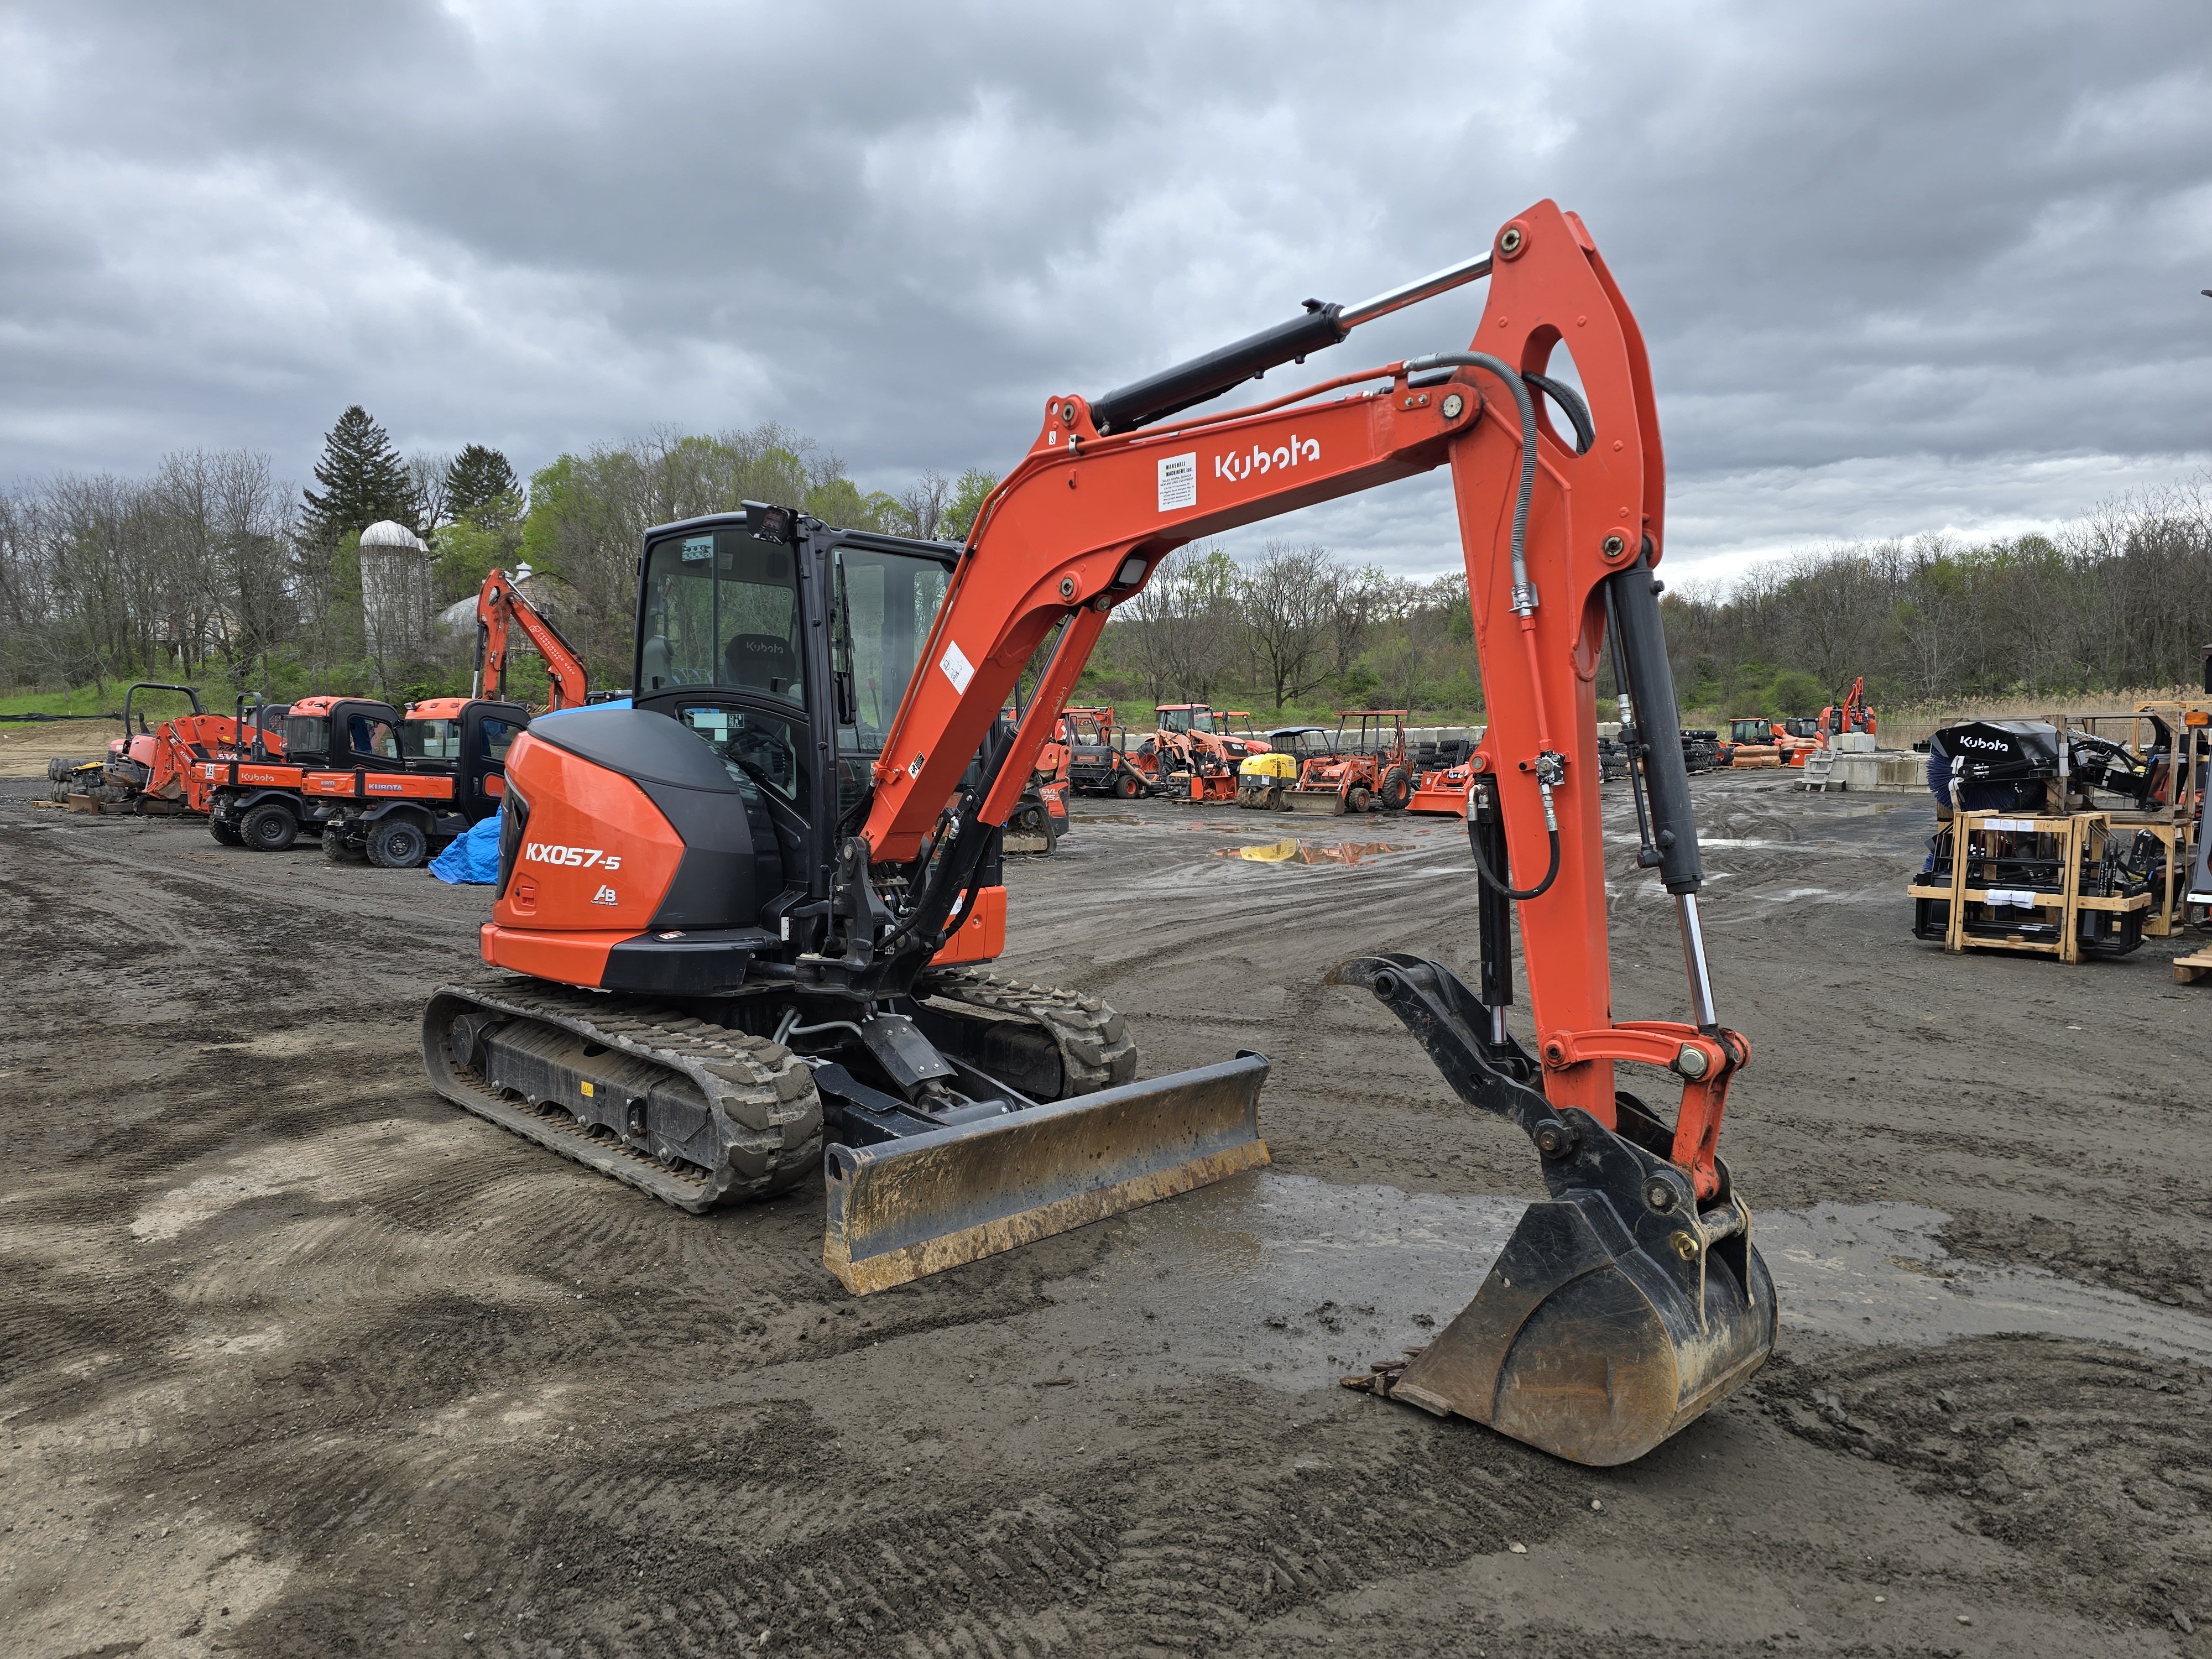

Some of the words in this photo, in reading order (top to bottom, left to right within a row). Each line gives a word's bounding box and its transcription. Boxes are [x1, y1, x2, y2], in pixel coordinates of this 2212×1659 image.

[1215, 434, 1320, 482] Kubota
[538, 634, 559, 660] LANDSCAPE
[540, 632, 564, 661] PENNINGTON
[564, 662, 575, 675] GREY
[747, 641, 784, 654] Kubota
[1960, 735, 2008, 752] Kubota
[180, 750, 192, 764] KUBO
[241, 773, 274, 782] Kubota
[368, 784, 403, 792] KUBOTA
[525, 842, 622, 870] KX057-5
[593, 884, 616, 902] AB
